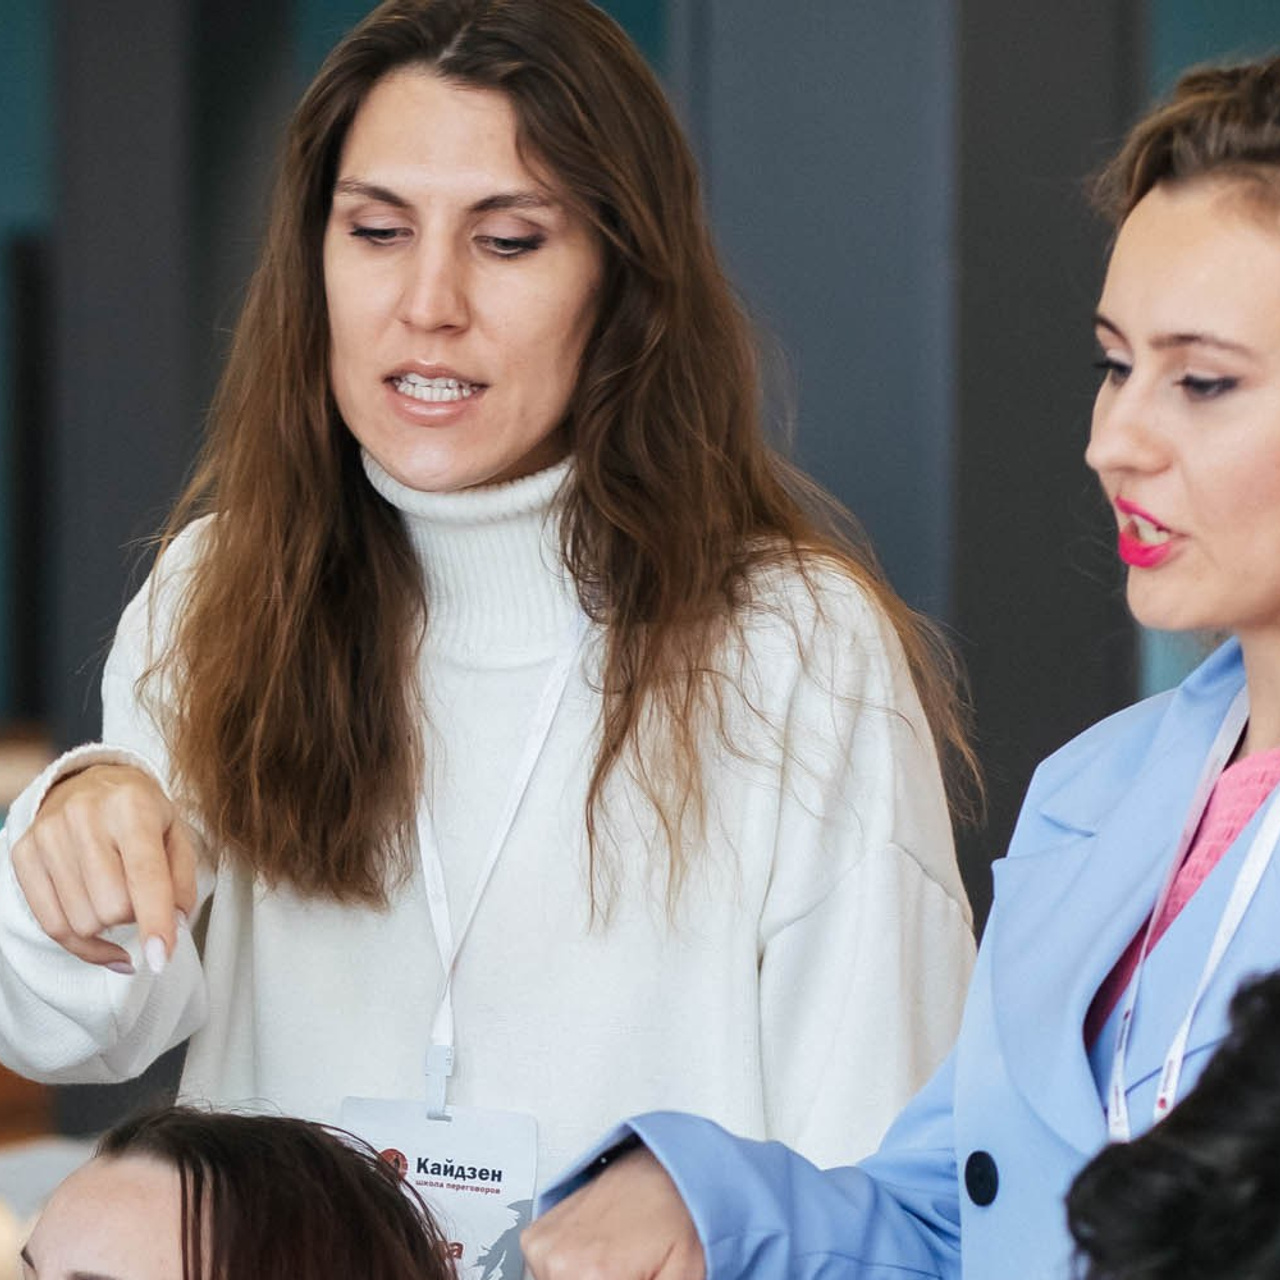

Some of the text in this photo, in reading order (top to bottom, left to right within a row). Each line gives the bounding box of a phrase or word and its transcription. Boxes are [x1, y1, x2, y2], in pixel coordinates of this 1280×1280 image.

[417, 1158, 502, 1182] Кайдзен
[415, 1179, 501, 1195] школа переговоров
